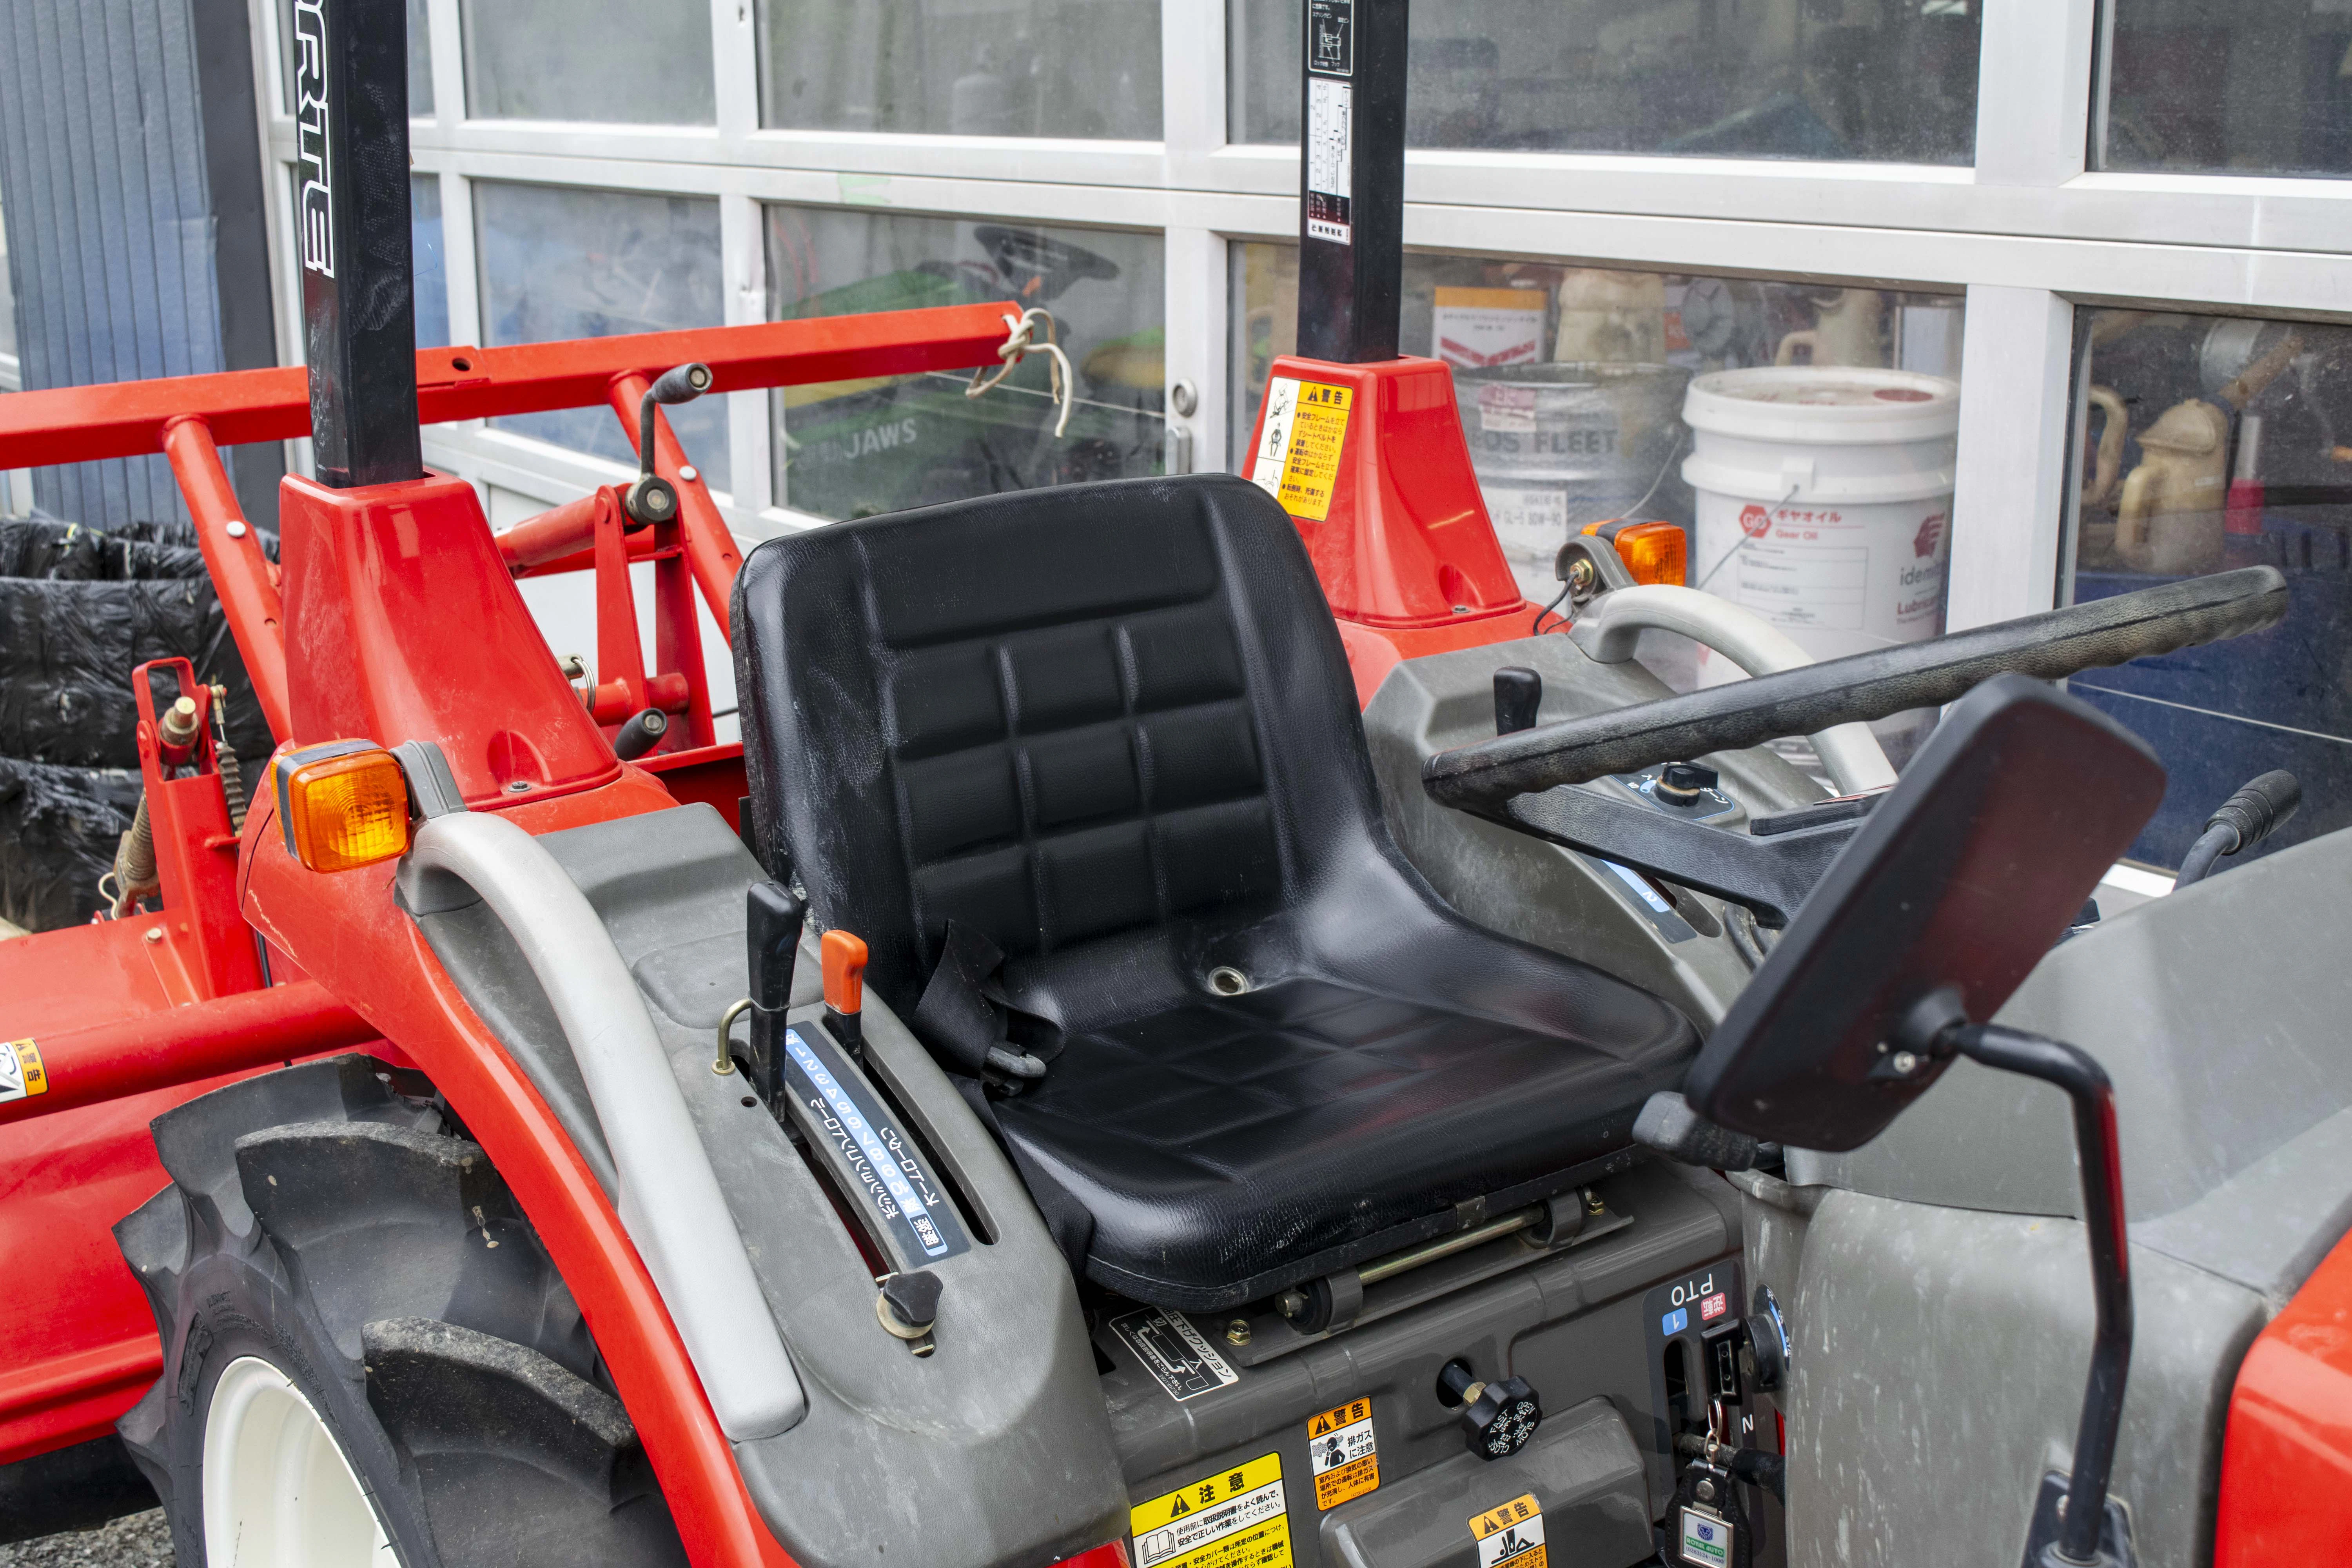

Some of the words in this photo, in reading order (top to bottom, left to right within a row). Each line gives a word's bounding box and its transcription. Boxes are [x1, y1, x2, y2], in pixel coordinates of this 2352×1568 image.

[1322, 389, 1343, 405] 警告
[1301, 412, 1345, 426] 安全フレームを立て
[1298, 430, 1336, 443] ずシートベルトを
[1300, 421, 1343, 435] ているときはかなら
[844, 417, 917, 459] JAWS
[1534, 429, 1619, 454] FLEET
[1642, 891, 1658, 902] 2
[795, 1047, 806, 1057] 1
[22, 1052, 41, 1082] 警告
[803, 1059, 818, 1071] 2
[815, 1073, 829, 1085] 3
[826, 1088, 838, 1100] 4
[837, 1101, 852, 1114] 5
[847, 1116, 862, 1129] 6
[863, 1132, 875, 1145] 7
[810, 1098, 899, 1219] ポジションコントロール
[869, 1147, 885, 1161] 8
[880, 1127, 940, 1207] オートロータリ
[881, 1163, 896, 1177] 9
[889, 1180, 909, 1196] 10
[913, 1217, 940, 1246] 解除
[1671, 1273, 1713, 1307] PTO
[1702, 1294, 1724, 1317] 逆転
[1153, 1317, 1167, 1327] 切
[1672, 1314, 1679, 1330] 1
[1189, 1359, 1203, 1369] 入
[1334, 1402, 1364, 1426] 警告
[1516, 1401, 1536, 1414] OPEN
[1490, 1409, 1508, 1433] FAST
[1742, 1414, 1754, 1434] N
[1347, 1430, 1372, 1447] 排ガス
[1516, 1421, 1535, 1446] SLOW
[1349, 1442, 1374, 1459] に注意
[1488, 1439, 1510, 1454] CLOSE
[1319, 1457, 1373, 1484] 室内および換気の悪い
[1320, 1466, 1374, 1491] 場所での運転は排ガス
[1199, 1471, 1245, 1504] 注意
[1321, 1472, 1375, 1499] が充満し、人体に有害
[1322, 1498, 1336, 1506] です。
[1176, 1490, 1279, 1537] 使用前に取扱説明書をよく読んで、
[1497, 1501, 1530, 1525] 警告
[1177, 1503, 1281, 1547] 安全で正しい作業をしてください。
[1171, 1524, 1285, 1568] 装置・安全カバー類は所定の位置につけ、
[1686, 1537, 1705, 1550] ROYAL
[1706, 1545, 1723, 1556] AUTO
[1686, 1546, 1724, 1564] (0263)24-1000
